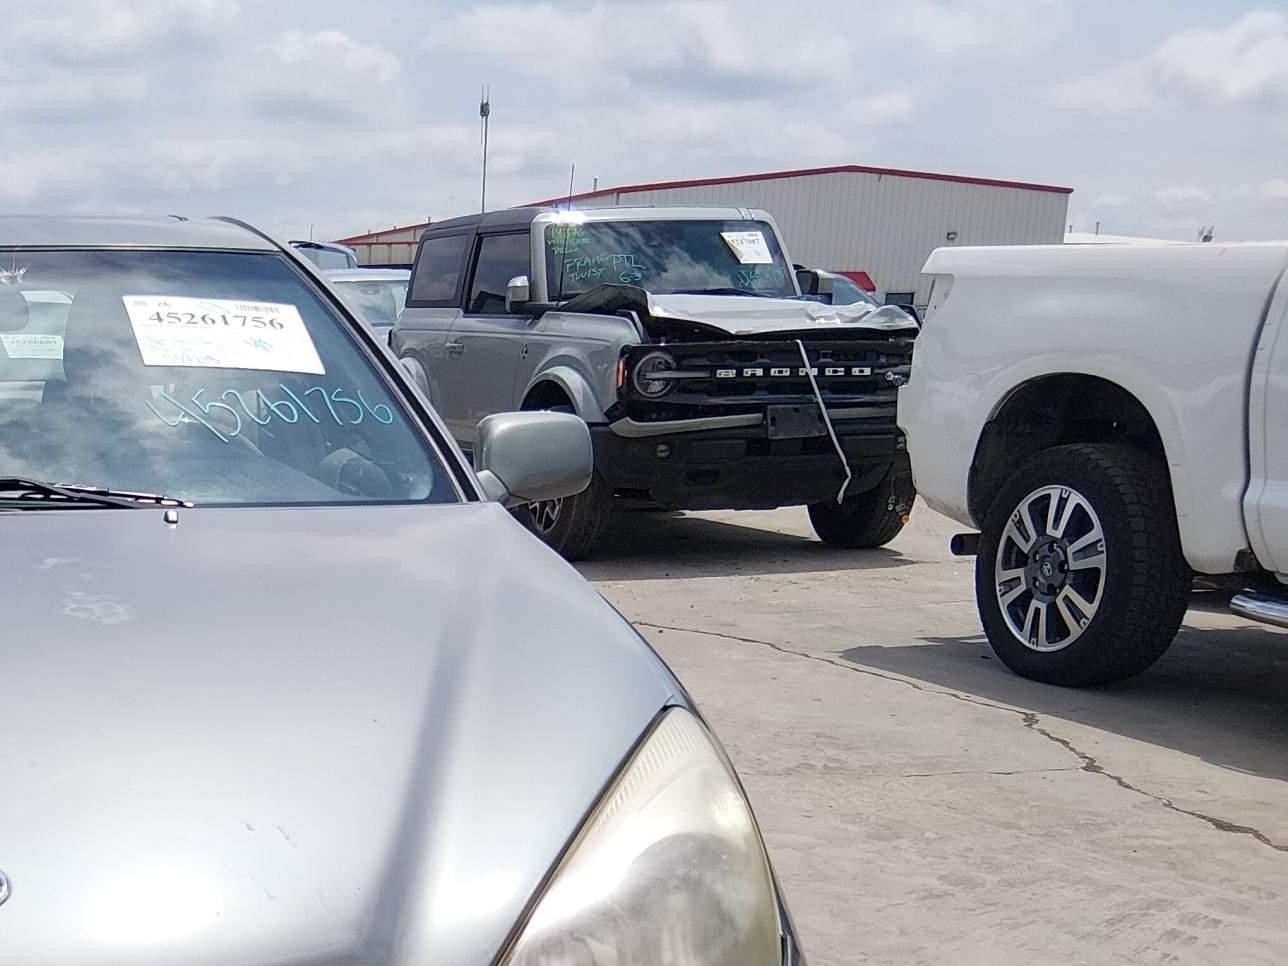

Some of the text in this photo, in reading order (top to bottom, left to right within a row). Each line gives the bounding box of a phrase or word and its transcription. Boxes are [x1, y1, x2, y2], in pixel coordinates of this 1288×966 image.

[148, 311, 285, 331] 45261756
[716, 367, 872, 379] BRONCO
[145, 383, 394, 444] 45261756
